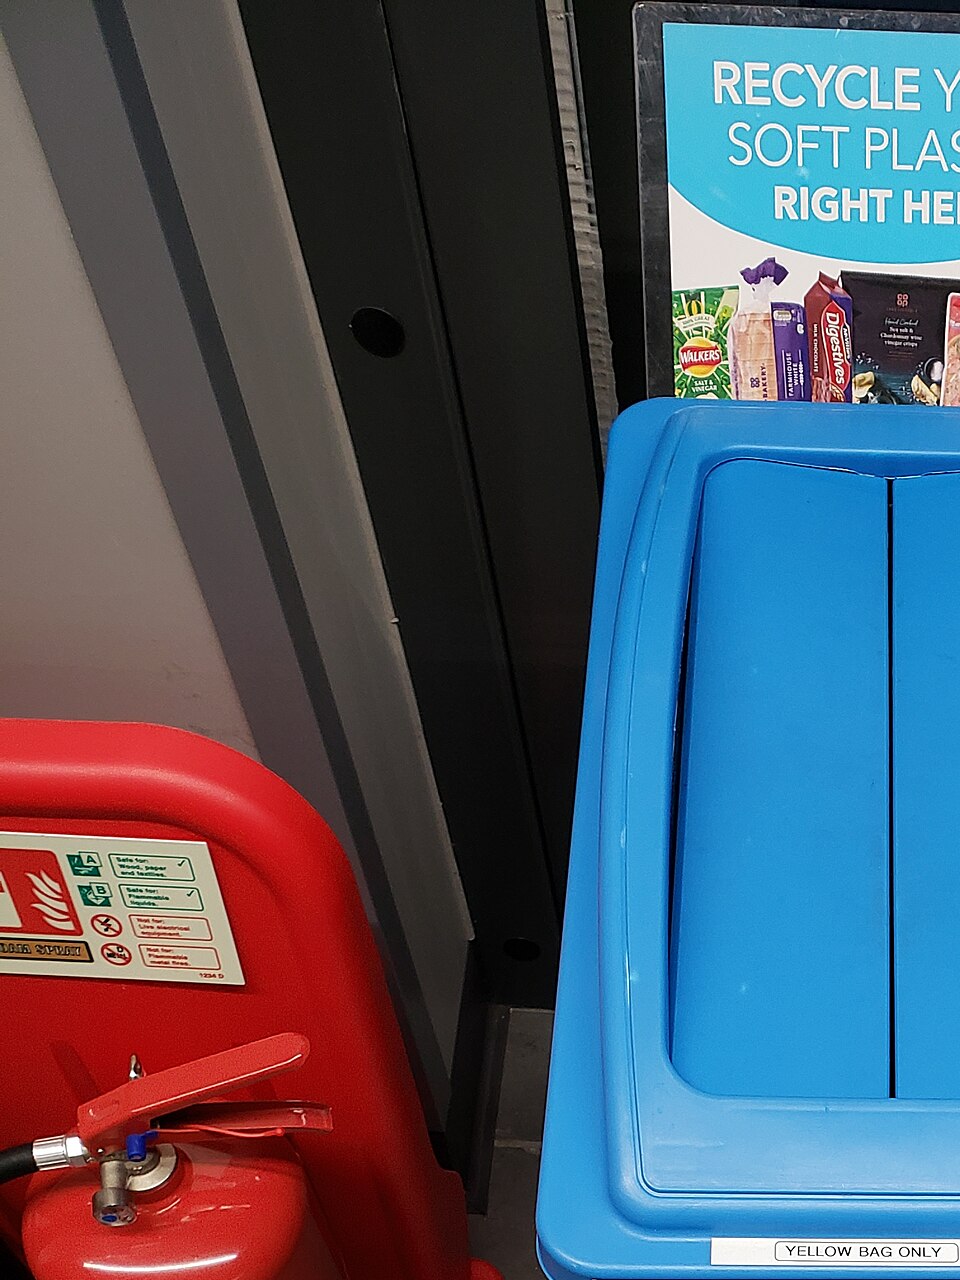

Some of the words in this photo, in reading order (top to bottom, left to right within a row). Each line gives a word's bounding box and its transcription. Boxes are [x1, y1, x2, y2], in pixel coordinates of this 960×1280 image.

[713, 61, 921, 110] RECYCLE
[728, 122, 849, 168] SOFT
[774, 186, 892, 223] RIGHT
[680, 349, 721, 363] WALKERS
[826, 312, 845, 385] Digestives
[87, 855, 96, 864] A
[96, 886, 106, 894] B
[786, 1245, 852, 1257] YELLOW
[859, 1246, 892, 1258] BAG
[898, 1247, 942, 1258] ONLY
